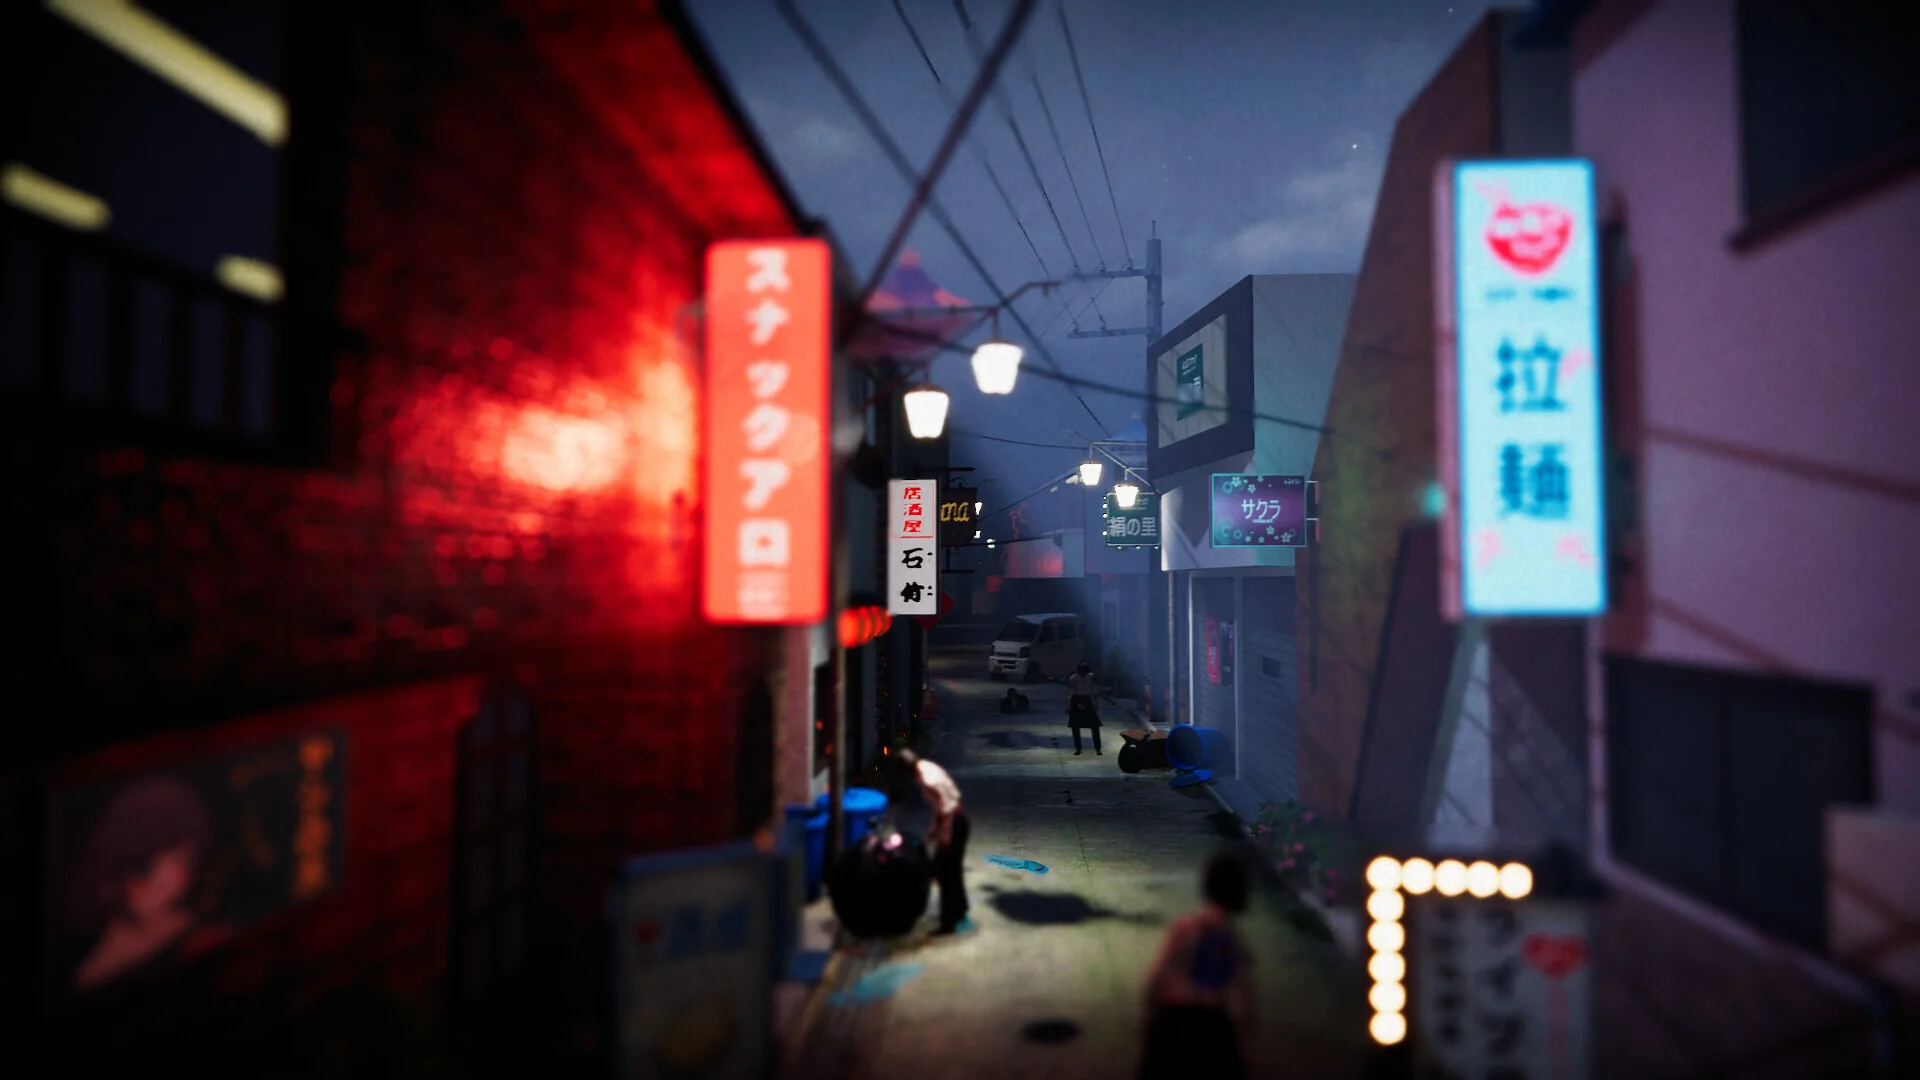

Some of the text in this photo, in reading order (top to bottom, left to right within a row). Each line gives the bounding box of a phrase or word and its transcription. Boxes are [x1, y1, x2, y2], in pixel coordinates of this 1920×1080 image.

[903, 487, 922, 533] 居酒屋
[1241, 499, 1281, 519] サクラ
